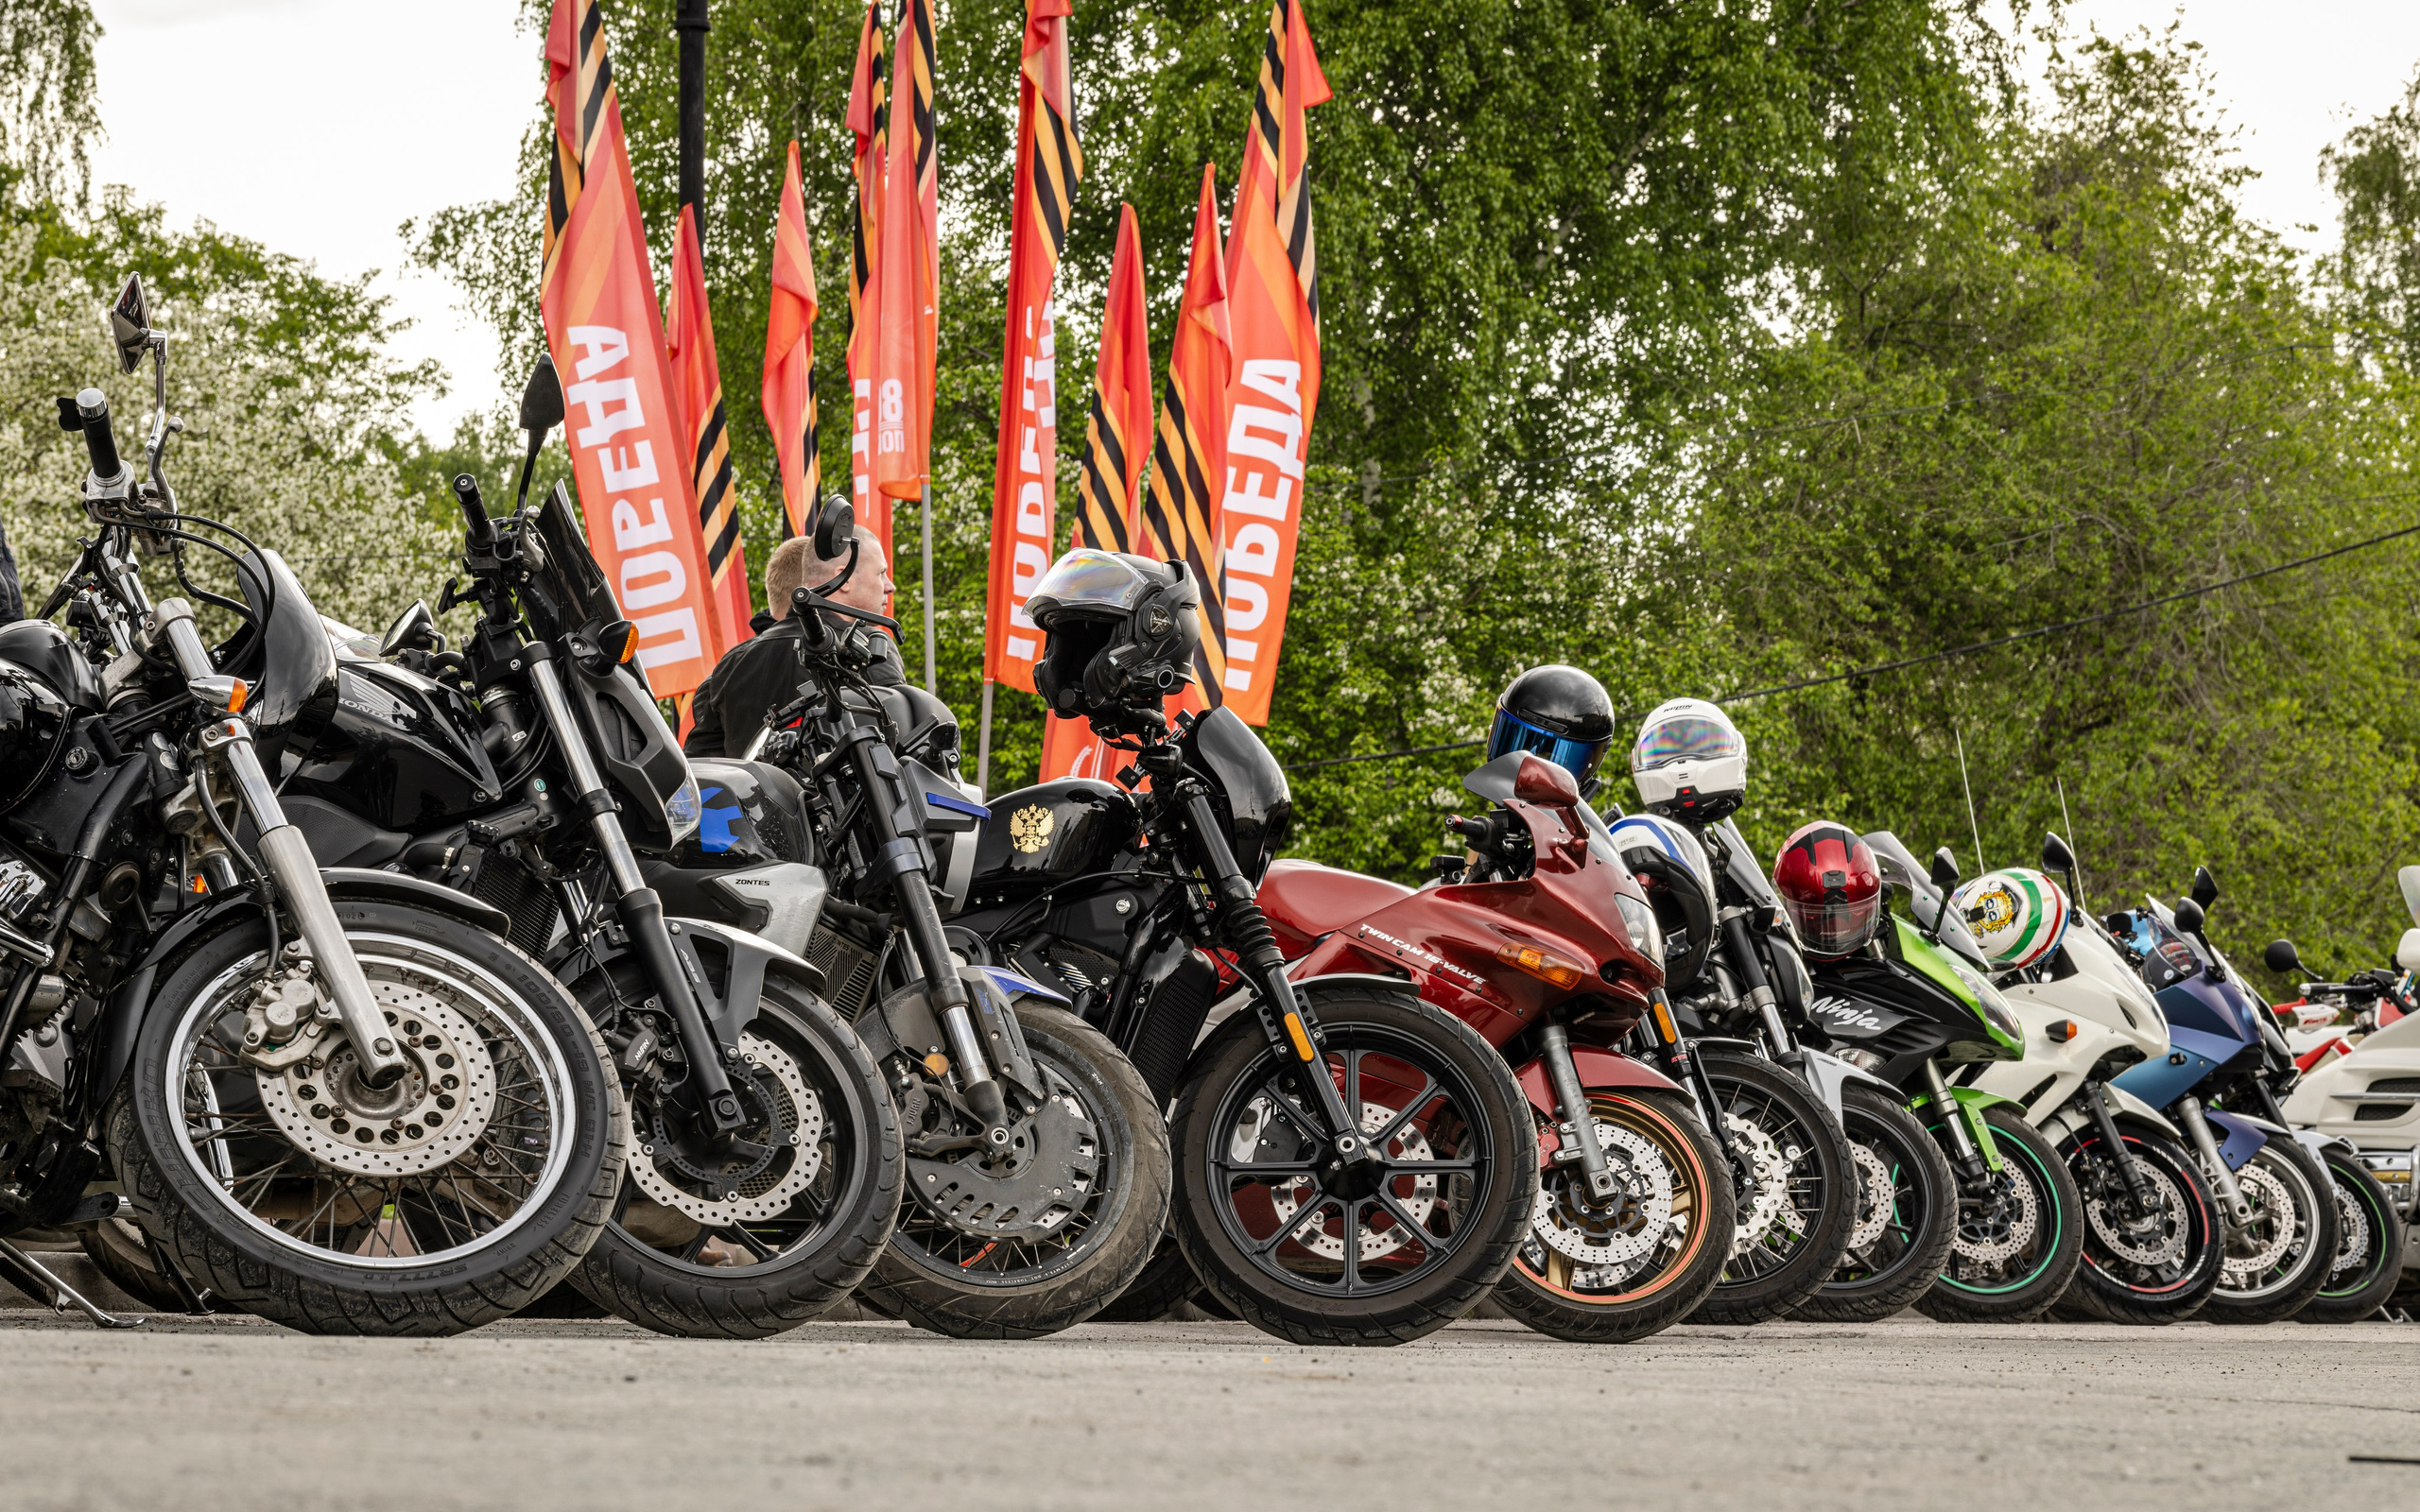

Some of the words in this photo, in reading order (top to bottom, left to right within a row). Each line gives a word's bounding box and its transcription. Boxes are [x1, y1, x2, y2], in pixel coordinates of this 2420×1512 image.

[1223, 358, 1304, 692] ПОБЕДА
[735, 878, 770, 886] ZONTES
[680, 948, 701, 984] ABS
[1360, 922, 1395, 943] TWIN
[1392, 938, 1425, 956] CAM
[1424, 952, 1487, 985] 16-VALVE
[1810, 995, 1882, 1031] Ninja
[906, 1096, 922, 1127] J.JUAN
